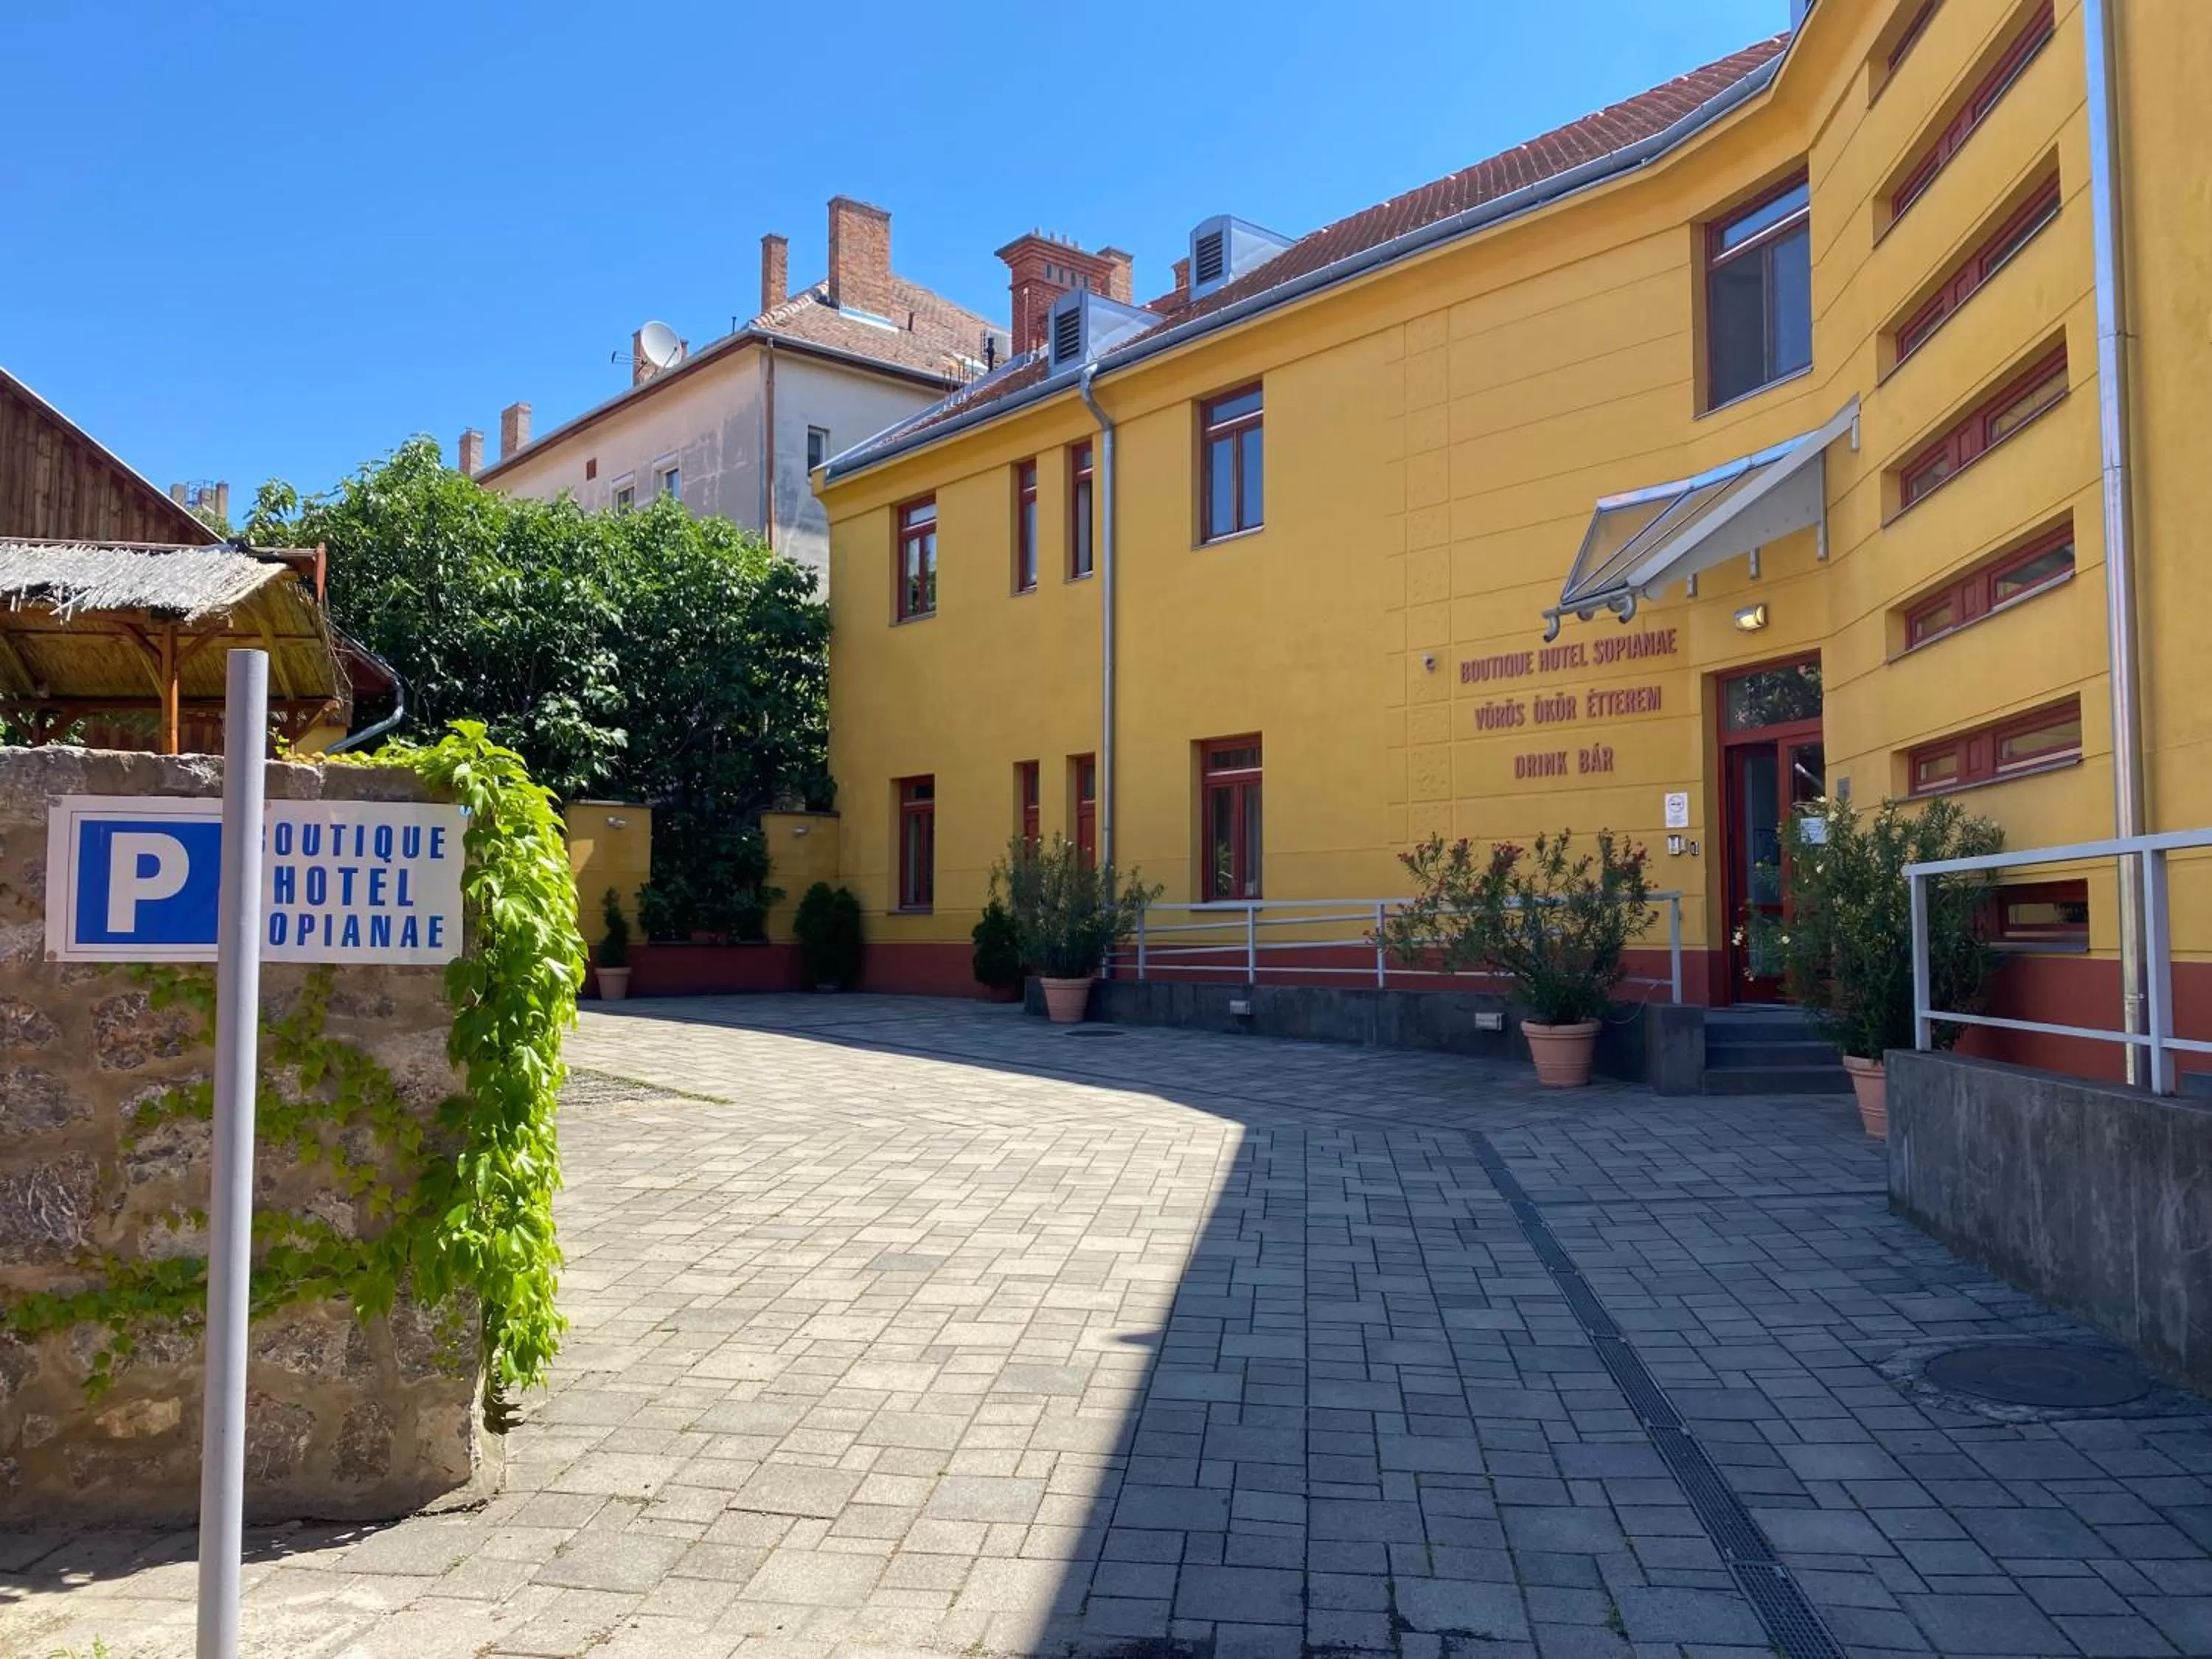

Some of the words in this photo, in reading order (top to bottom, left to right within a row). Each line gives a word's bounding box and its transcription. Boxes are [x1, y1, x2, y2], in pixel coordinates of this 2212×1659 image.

[1460, 652, 1534, 684] BOUTIQUE
[1539, 644, 1589, 672] HOTEL
[1593, 629, 1678, 665] SOPIANAE
[1475, 699, 1526, 731] VÖRÖS
[1586, 686, 1662, 718] ÉTTEREM
[1514, 753, 1568, 779] DRINK
[1578, 743, 1614, 773] BÁR
[262, 822, 446, 863] OUTIQUE
[107, 832, 189, 933] P
[274, 866, 414, 906] HOTEL
[268, 912, 444, 947] OPIANAE
